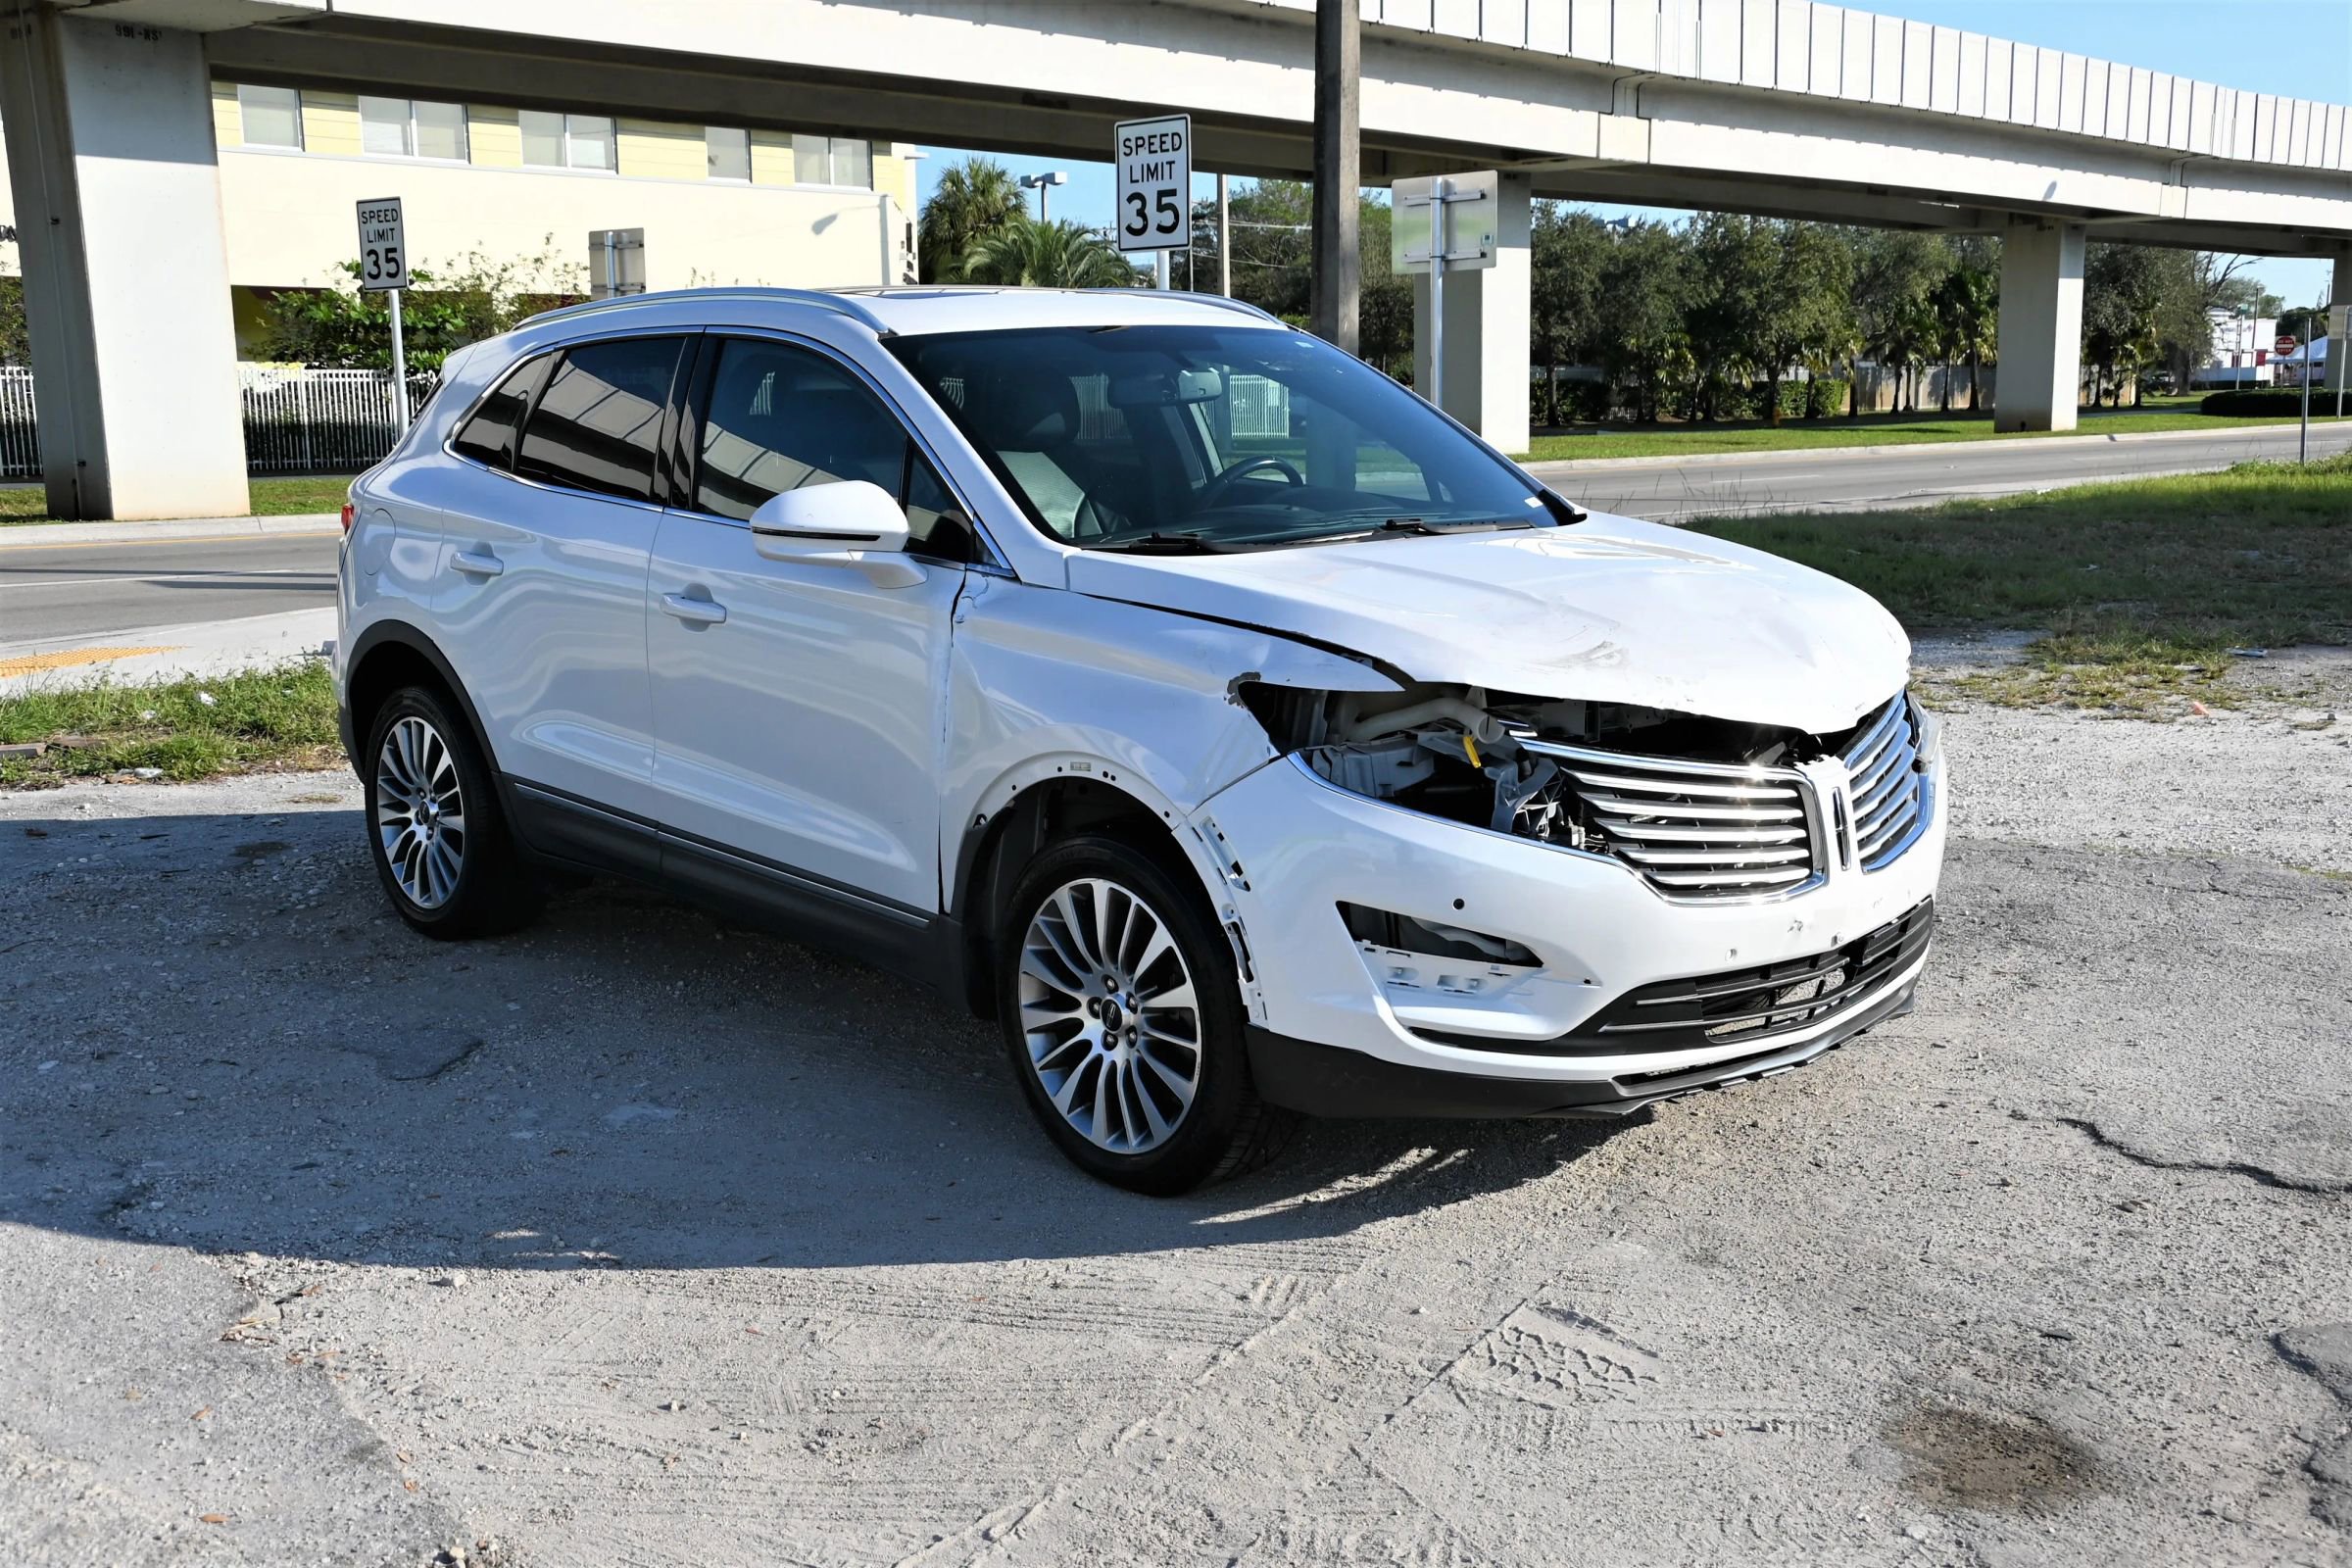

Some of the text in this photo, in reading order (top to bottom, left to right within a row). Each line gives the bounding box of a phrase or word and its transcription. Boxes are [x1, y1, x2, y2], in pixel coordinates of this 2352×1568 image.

[1122, 131, 1183, 157] SPEED
[1129, 161, 1176, 184] LIMIT
[361, 208, 399, 224] SPEED
[1125, 187, 1180, 237] 35
[367, 227, 395, 243] LIMIT
[366, 247, 400, 280] 35
